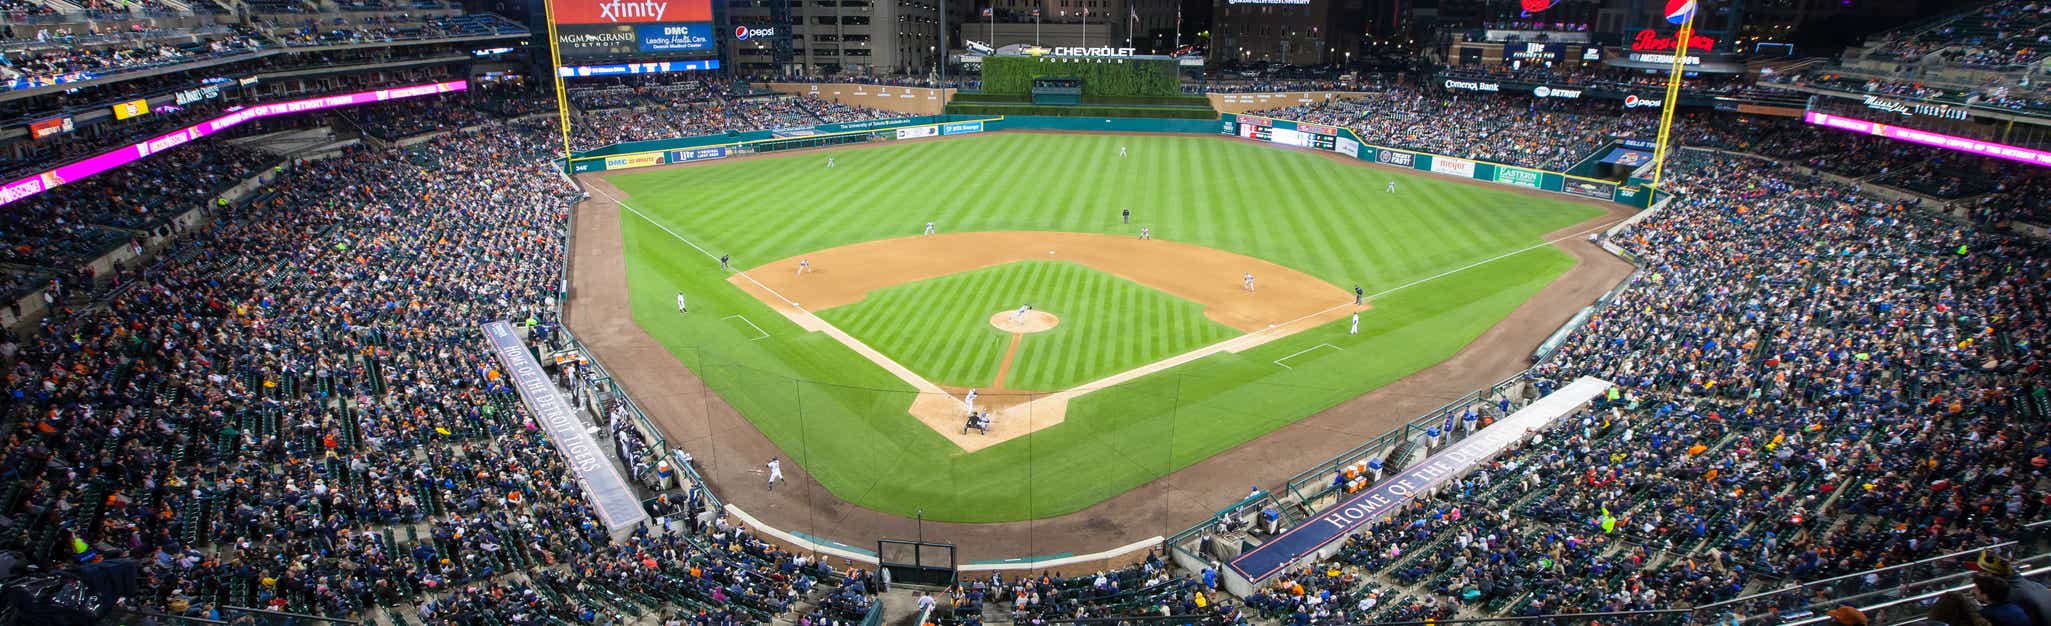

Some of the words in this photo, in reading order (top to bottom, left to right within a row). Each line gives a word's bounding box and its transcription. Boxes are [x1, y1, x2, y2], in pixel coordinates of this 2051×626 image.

[600, 0, 668, 22] xfinity
[560, 34, 584, 43] MGM
[599, 32, 633, 42] GRAND
[664, 26, 689, 35] DMC
[749, 26, 775, 38] pepsi
[1055, 47, 1136, 57] CHEVROLET
[1478, 82, 1500, 92] Bank
[1550, 89, 1581, 99] DETROIT
[288, 99, 323, 113] DETROIT
[1638, 99, 1662, 107] pepsi
[1440, 158, 1465, 170] meijer
[1500, 167, 1537, 181] EASTERN
[504, 345, 529, 366] HOME
[518, 365, 537, 379] OF
[524, 378, 549, 396] THE
[534, 393, 574, 435] DETROIT
[563, 433, 601, 473] TIGERS
[1324, 493, 1391, 530] HOME
[1388, 478, 1417, 498] OF
[1411, 460, 1454, 482] THE
